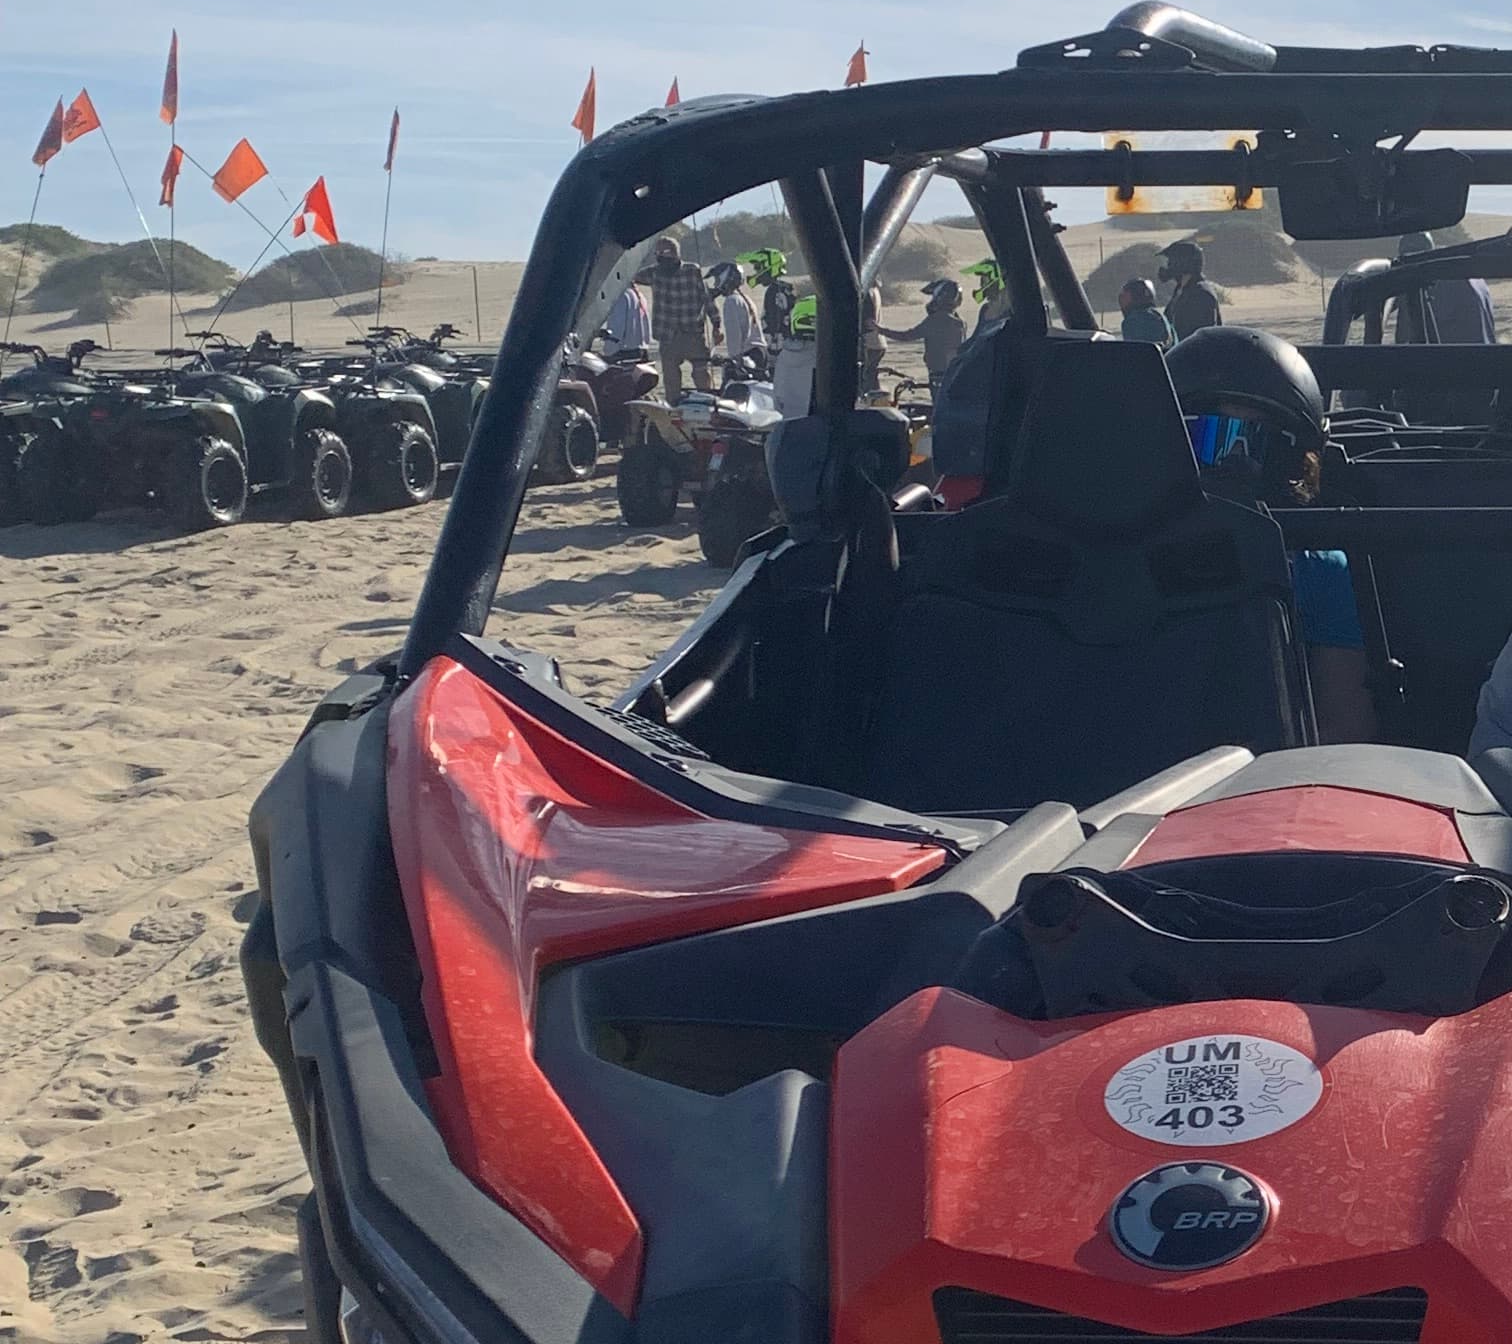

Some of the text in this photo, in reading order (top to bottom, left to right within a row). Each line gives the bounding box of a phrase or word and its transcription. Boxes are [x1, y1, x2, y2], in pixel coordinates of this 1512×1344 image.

[1164, 1041, 1241, 1065] UM
[1154, 1105, 1246, 1130] 403
[1173, 1210, 1259, 1231] BRP
